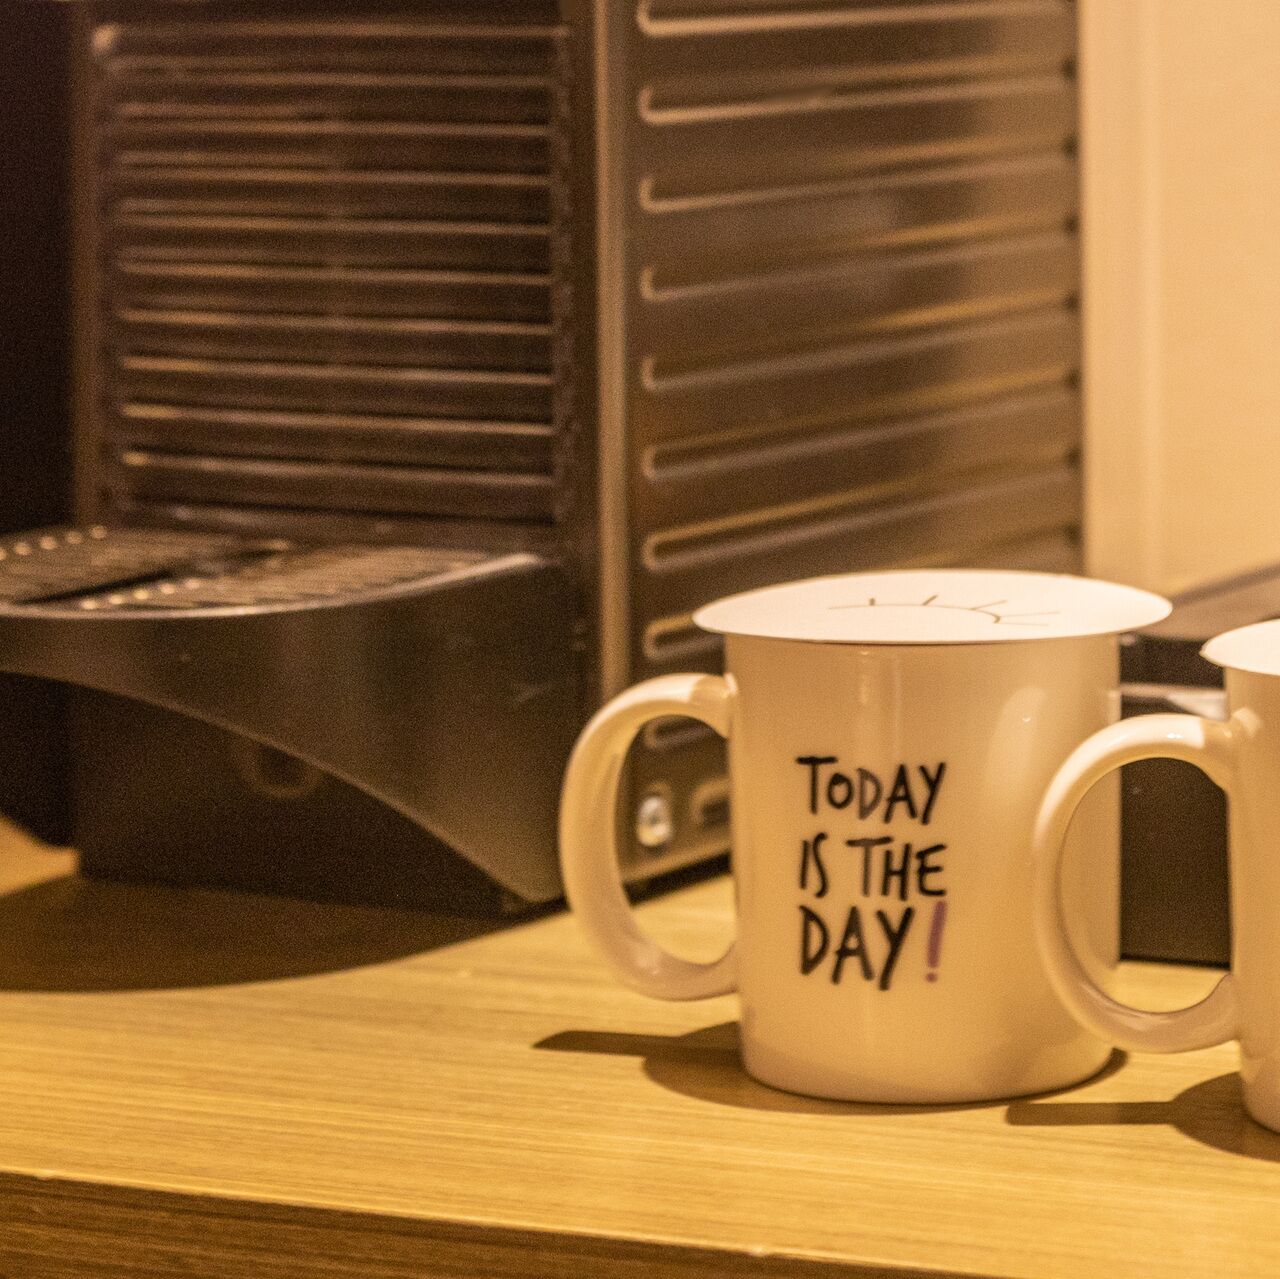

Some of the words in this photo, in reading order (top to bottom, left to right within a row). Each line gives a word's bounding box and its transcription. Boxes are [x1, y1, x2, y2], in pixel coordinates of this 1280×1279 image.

[796, 755, 947, 825] TODAY
[799, 832, 828, 899] IS
[846, 836, 947, 902] THE
[799, 900, 947, 991] DAY!
